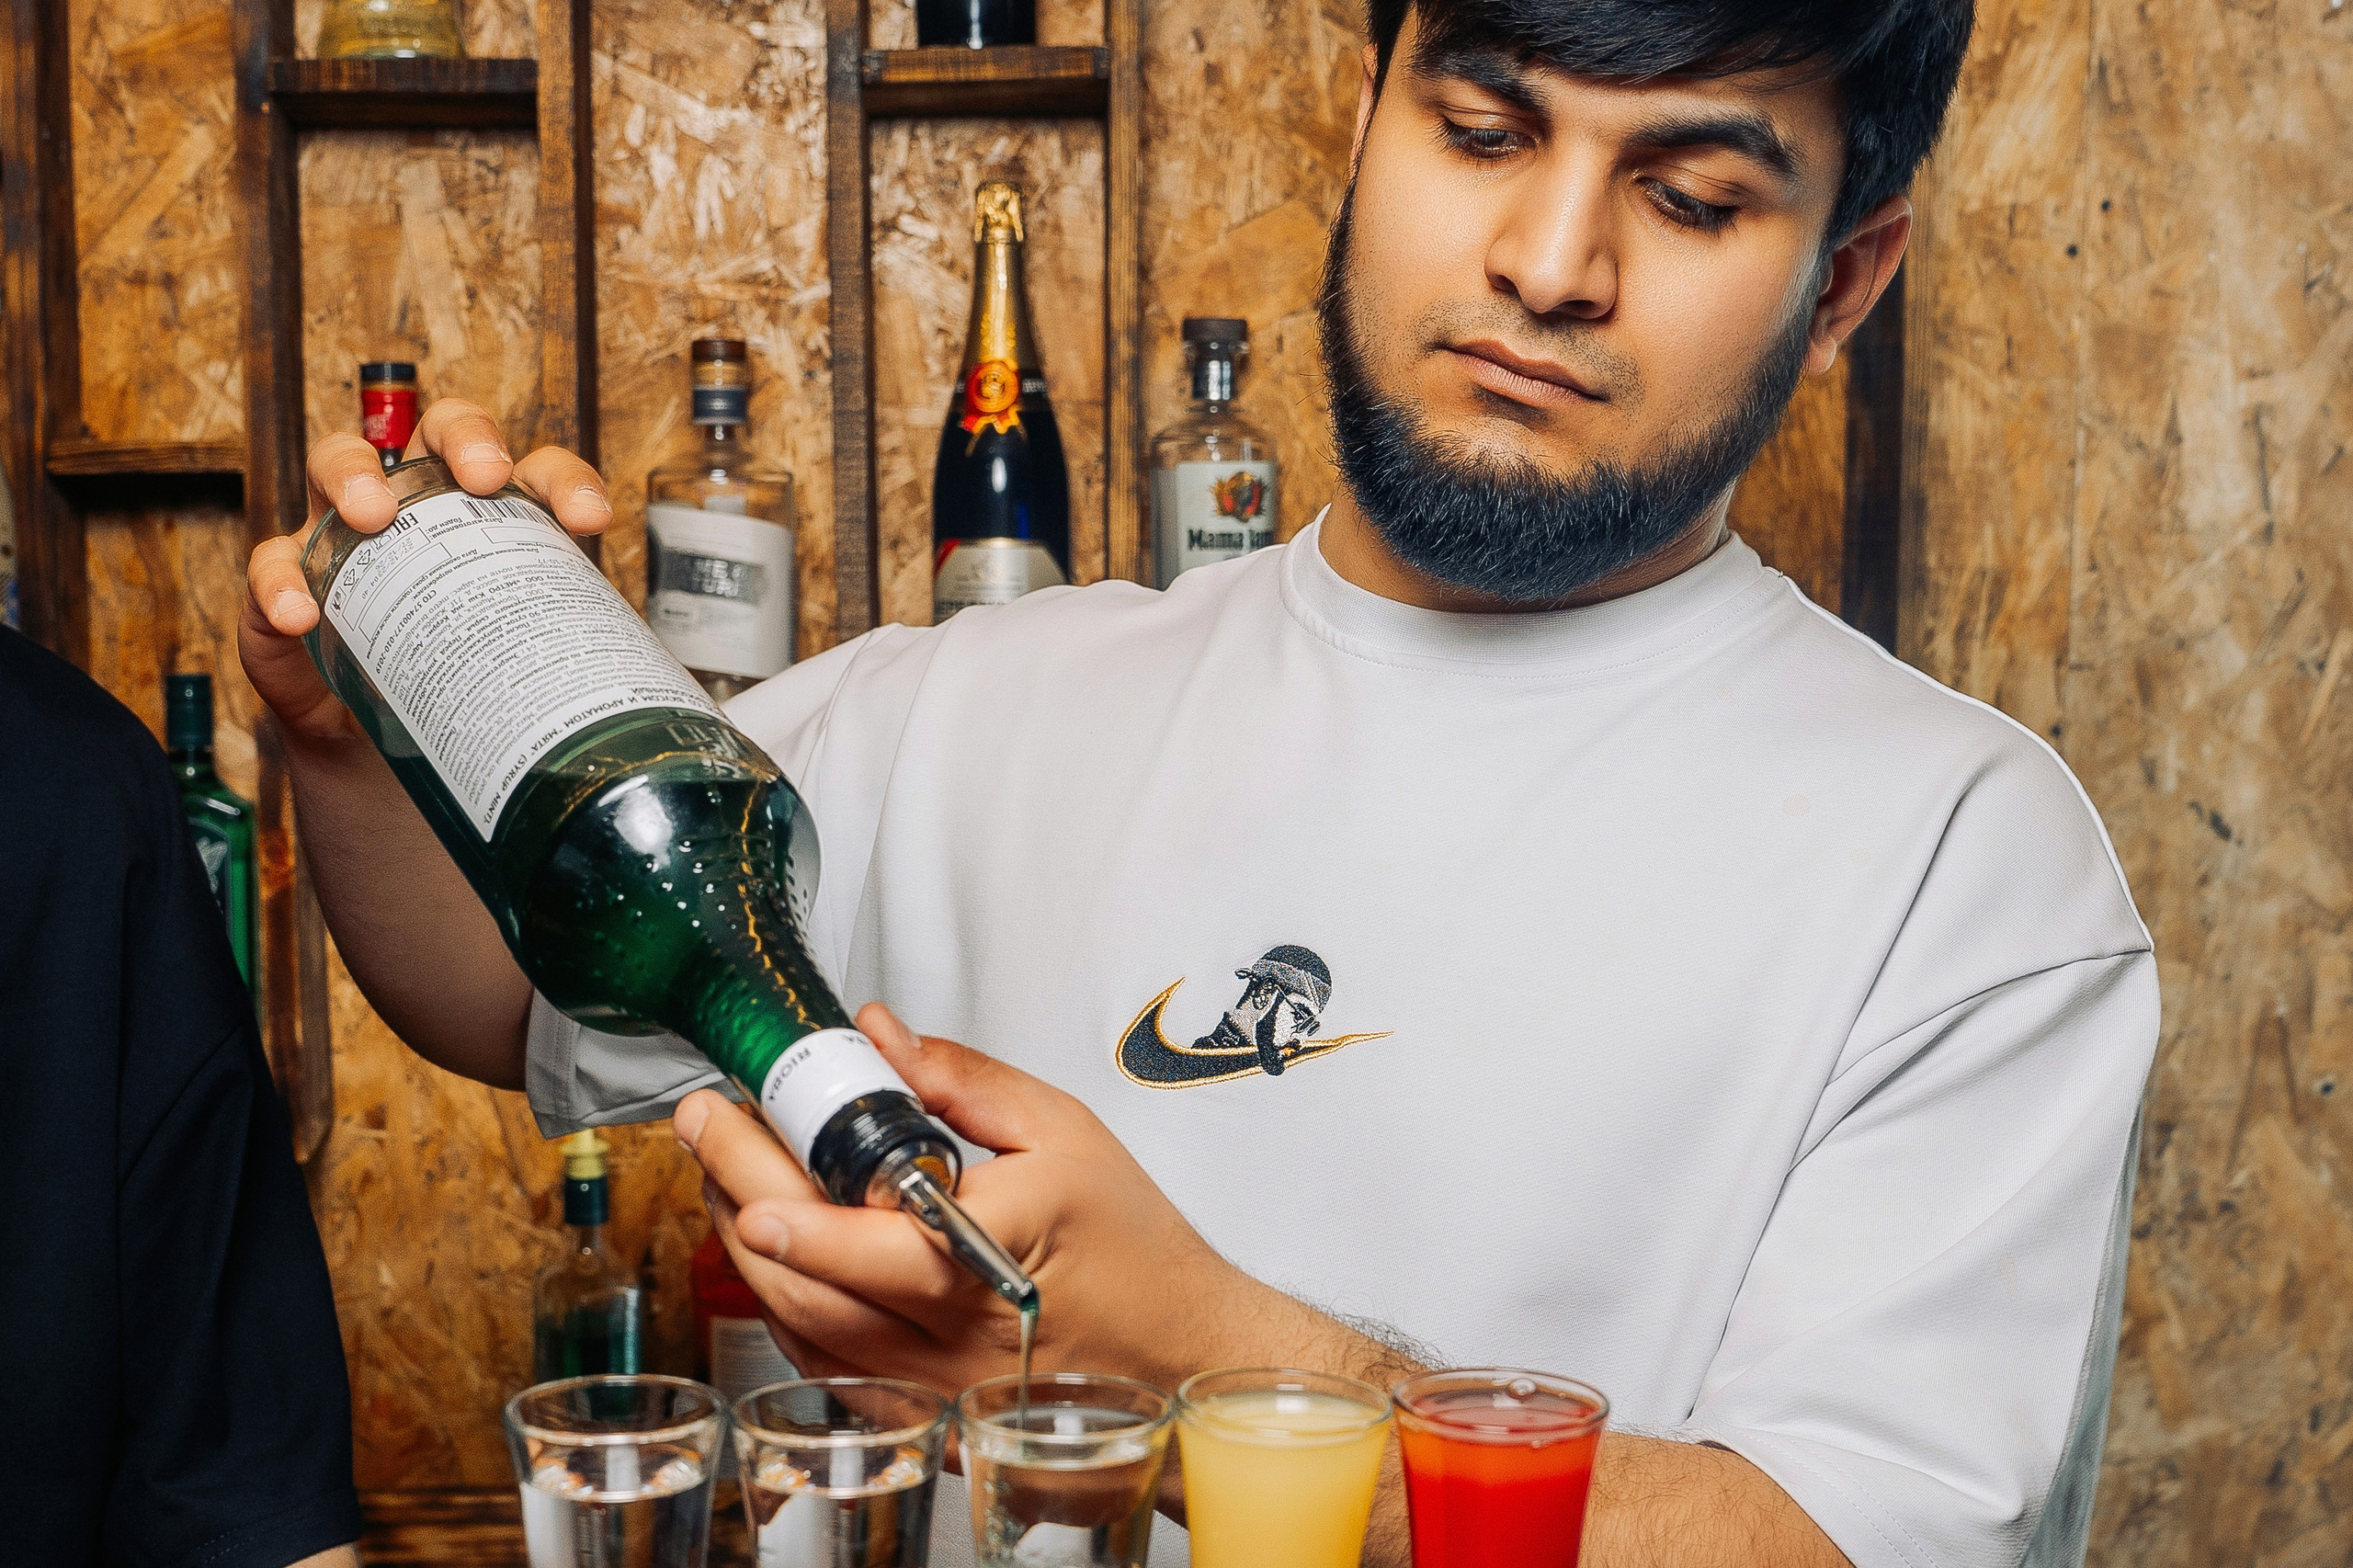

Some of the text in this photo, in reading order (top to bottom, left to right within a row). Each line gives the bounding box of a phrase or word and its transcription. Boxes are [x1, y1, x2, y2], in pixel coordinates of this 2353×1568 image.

[425, 517, 462, 534] Годен до:
[429, 519, 483, 540] изготовления:
[452, 551, 494, 569] информации
[489, 566, 513, 576] почте
[410, 568, 452, 601] потребителем:
[472, 577, 499, 590] шоссе,
[488, 579, 520, 593] «МЕТРО
[502, 569, 560, 579] Ленинградское
[449, 579, 474, 597] адрес:
[468, 591, 485, 603] Кэш
[503, 581, 536, 593] область,
[524, 588, 544, 597] ООО
[366, 548, 477, 659] Дата окончания срока годности после вскрытия
[448, 596, 463, 608] 71Г.
[449, 603, 465, 614] энд
[463, 595, 494, 612] Мценск,
[508, 605, 532, 616] также
[421, 607, 448, 631] Жалобы
[423, 615, 449, 638] Керри».
[449, 594, 520, 635] "Производственный
[451, 612, 463, 621] ул.
[476, 614, 507, 634] наличие
[503, 614, 527, 626] суток.
[530, 614, 554, 624] лучей.
[375, 589, 437, 674] СТО 37400177-010-2019
[382, 596, 449, 681] metro-brand@metro-cc.ru.
[505, 621, 529, 634] После
[506, 623, 546, 642] влажности
[529, 627, 563, 641] Условия
[541, 630, 578, 643] углеводы
[405, 640, 423, 665] Адрес:
[405, 594, 553, 714] используемого сырья. Перед употреблением
[408, 622, 452, 671] Комсомольская,
[424, 636, 448, 665] Холдинг
[446, 632, 475, 660] цветного
[455, 624, 503, 662] Допускаются:
[470, 633, 504, 658] вскрытия
[476, 642, 505, 664] воздуха
[489, 639, 528, 664] хранения:
[526, 643, 536, 652] 64
[539, 644, 586, 660] мороженое,
[540, 637, 580, 652] разводить
[388, 641, 414, 687] предложения
[445, 657, 470, 684] хранить
[467, 663, 475, 673] не
[506, 660, 537, 680] десерты
[515, 651, 539, 666] водой
[563, 660, 615, 676] (пальмовое),
[574, 653, 613, 665] регулятор
[391, 669, 405, 695] Россия,
[404, 673, 410, 681] д.
[425, 660, 446, 686] кольца,
[436, 661, 455, 685] легкая
[449, 672, 467, 693] более
[463, 663, 488, 687] хранить
[465, 653, 519, 697] Энергетическая
[506, 656, 569, 691] приготовлению:
[522, 665, 568, 689] кислотности
[559, 674, 588, 687] лютеин
[436, 684, 446, 699] при
[452, 687, 463, 701] при
[466, 668, 507, 708] соотношении
[492, 680, 504, 693] для
[505, 675, 562, 715] антиокислители:
[521, 685, 559, 712] (содержит
[536, 682, 587, 710] ароматизатор
[411, 687, 426, 720] обуслов-
[415, 685, 437, 727] опалесцен-
[462, 694, 490, 727] придания
[475, 688, 506, 722] добавлять
[536, 684, 613, 722] концентрированный
[563, 699, 623, 727] АРОМАТОМ
[420, 699, 437, 733] темпера-
[424, 711, 438, 741] избегая
[428, 702, 452, 747] температуре
[434, 697, 466, 753] ценность/кало-
[456, 710, 467, 722] 1:5.
[438, 725, 456, 761] Пищевая
[462, 726, 483, 755] натрия),
[482, 710, 520, 755] стабилизатор
[494, 721, 534, 765] виноградный
[530, 728, 563, 755] "МЯТА"
[443, 729, 462, 767] приятного
[448, 727, 472, 774] алкогольные
[479, 729, 513, 775] консерванты:
[453, 757, 464, 781] синий
[484, 764, 495, 778] сок,
[501, 754, 527, 790] (SYRUP
[468, 775, 480, 802] сорбат
[472, 778, 486, 808] регуля-
[483, 791, 501, 824] MINT).
[767, 1047, 812, 1100] RIOBA
